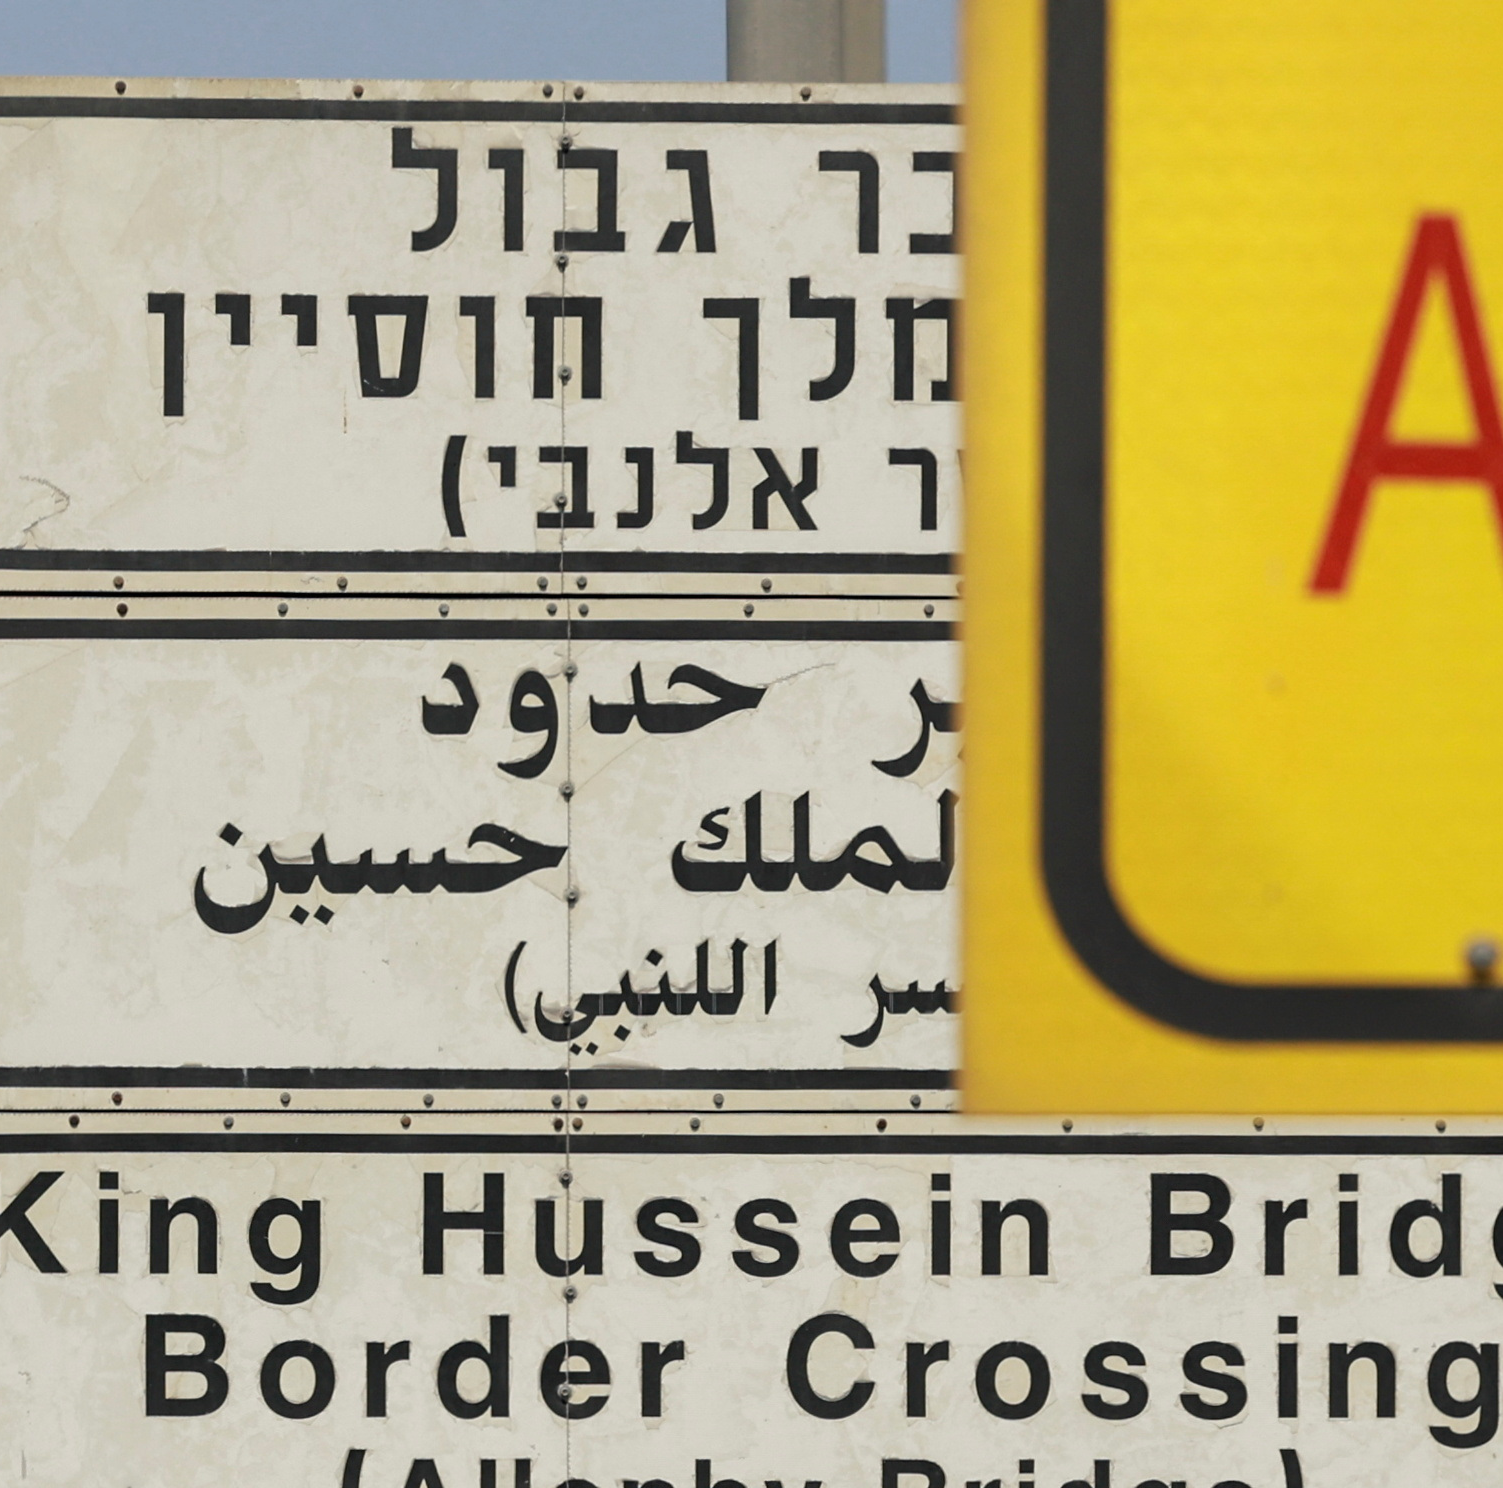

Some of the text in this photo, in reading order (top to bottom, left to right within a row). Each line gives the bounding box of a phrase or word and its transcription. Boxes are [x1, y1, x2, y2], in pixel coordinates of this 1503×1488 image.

[391, 127, 717, 253] גבול
[147, 292, 603, 417] חוסיין
[889, 446, 965, 531] ר
[421, 661, 964, 780] ر حدود
[194, 822, 569, 935] حسين
[422, 1172, 1049, 1278] Hussein
[145, 1313, 1500, 1449] Border Crossing
